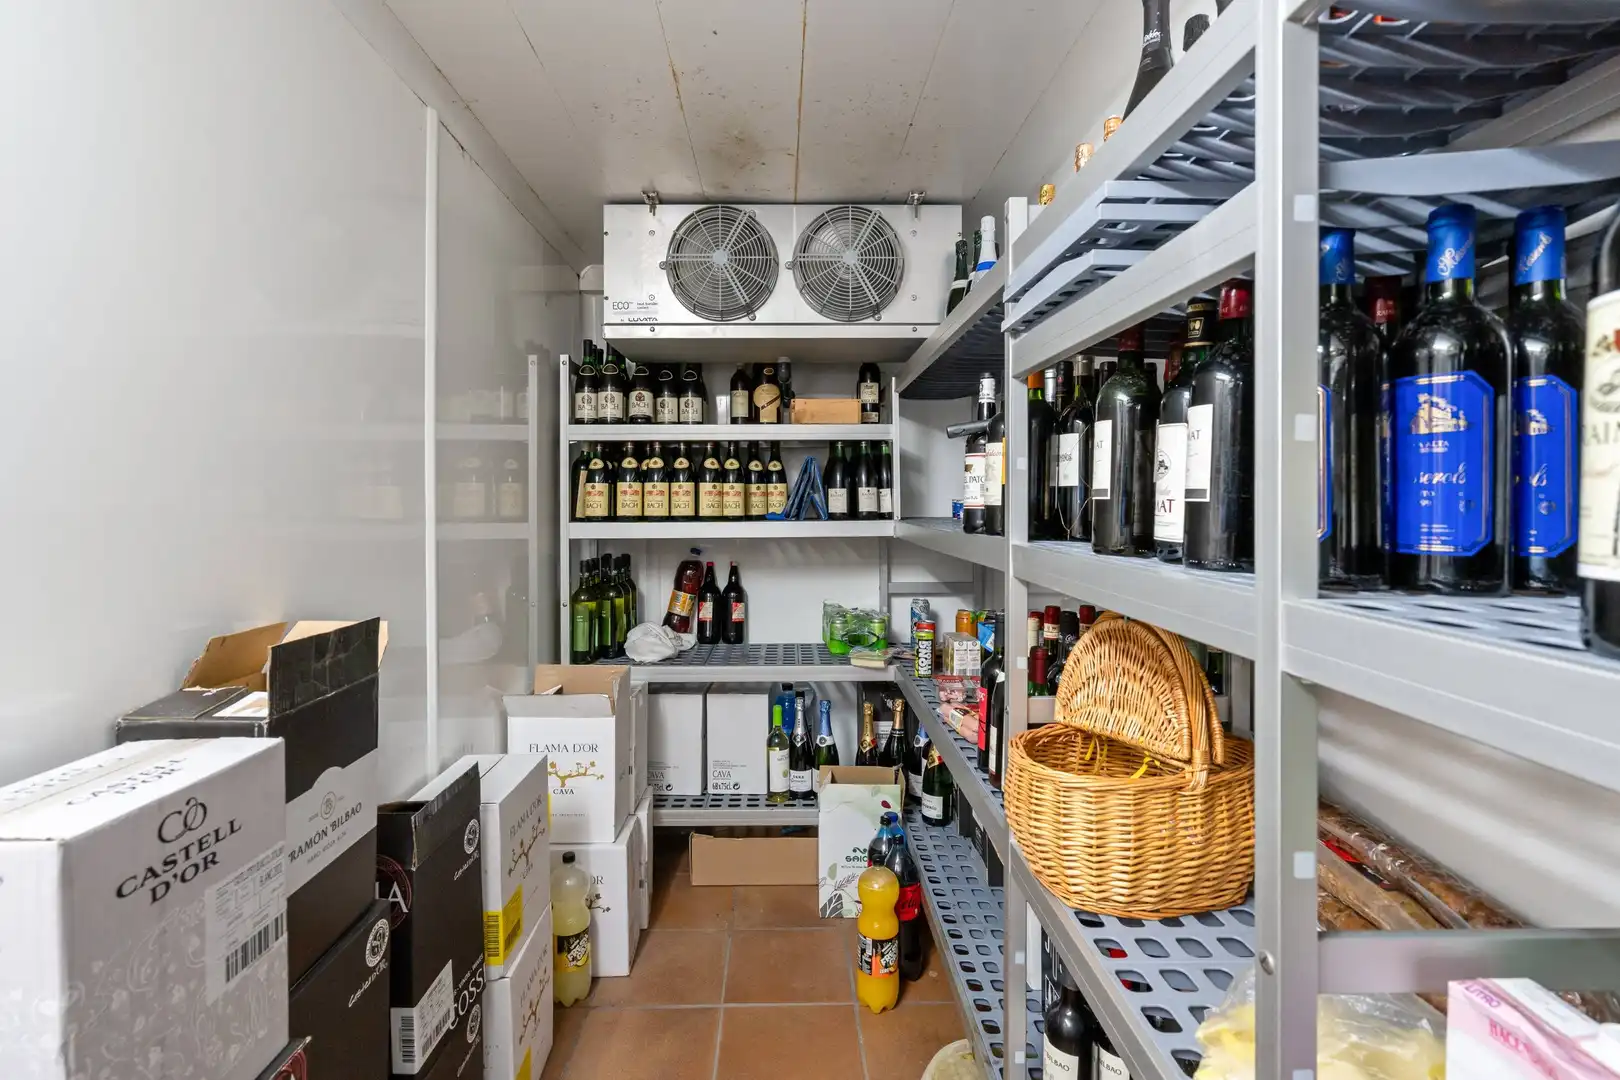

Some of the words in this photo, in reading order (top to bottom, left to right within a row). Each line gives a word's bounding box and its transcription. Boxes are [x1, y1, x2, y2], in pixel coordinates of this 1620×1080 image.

[612, 301, 630, 310] ECO
[529, 743, 569, 753] FLAMA
[573, 743, 599, 753] D'OR
[712, 770, 732, 778] CAVA
[288, 825, 329, 864] RAMÓN
[329, 801, 363, 832] BILBAO
[115, 817, 243, 899] CASTELL
[149, 851, 220, 906] D'OR
